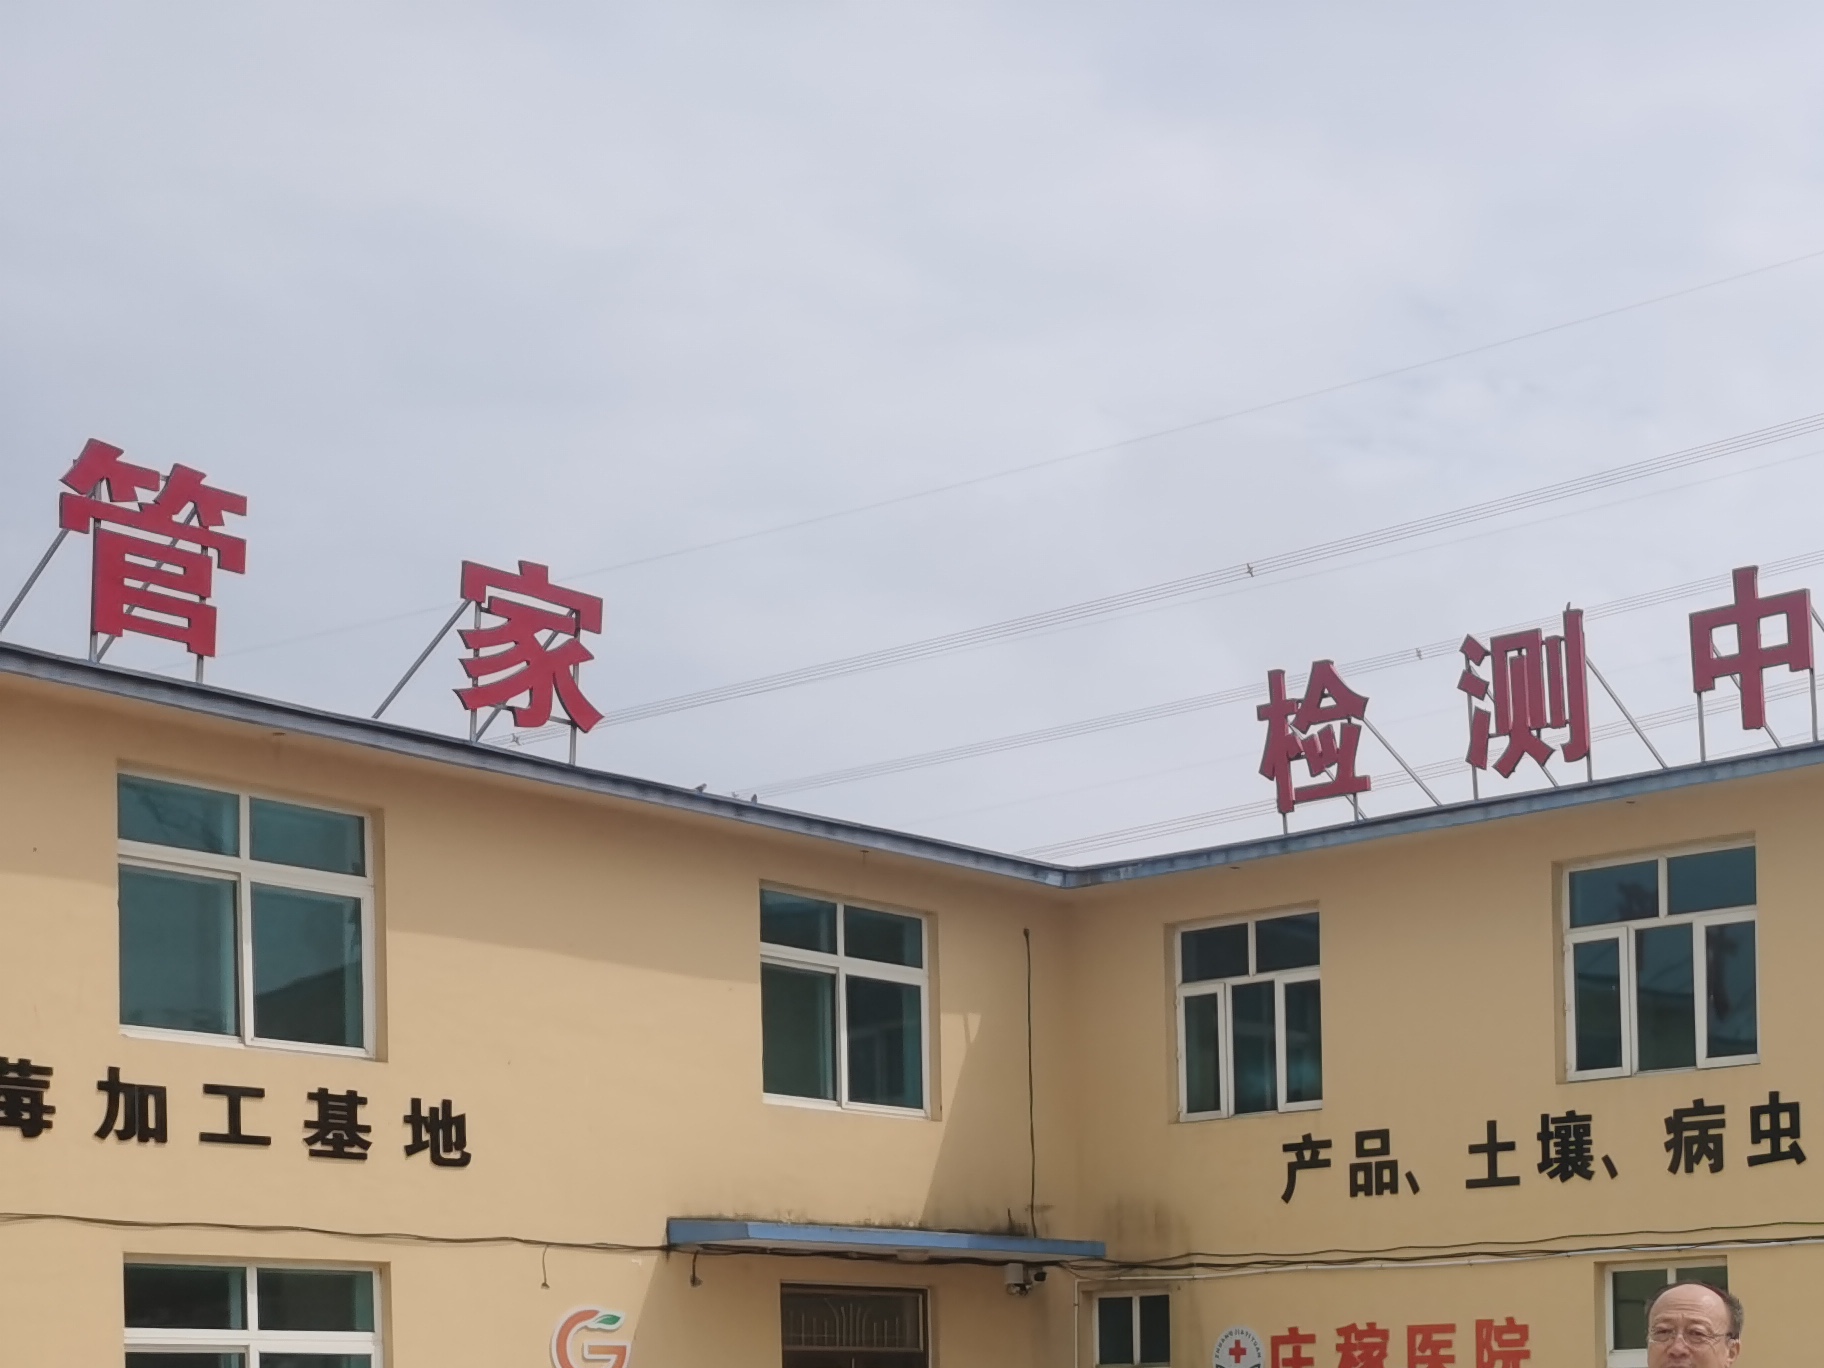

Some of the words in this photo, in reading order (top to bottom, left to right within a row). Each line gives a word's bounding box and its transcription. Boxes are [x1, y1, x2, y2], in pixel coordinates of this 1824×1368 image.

[59, 437, 604, 733] 管家
[0, 1056, 472, 1167] 莓加工基地
